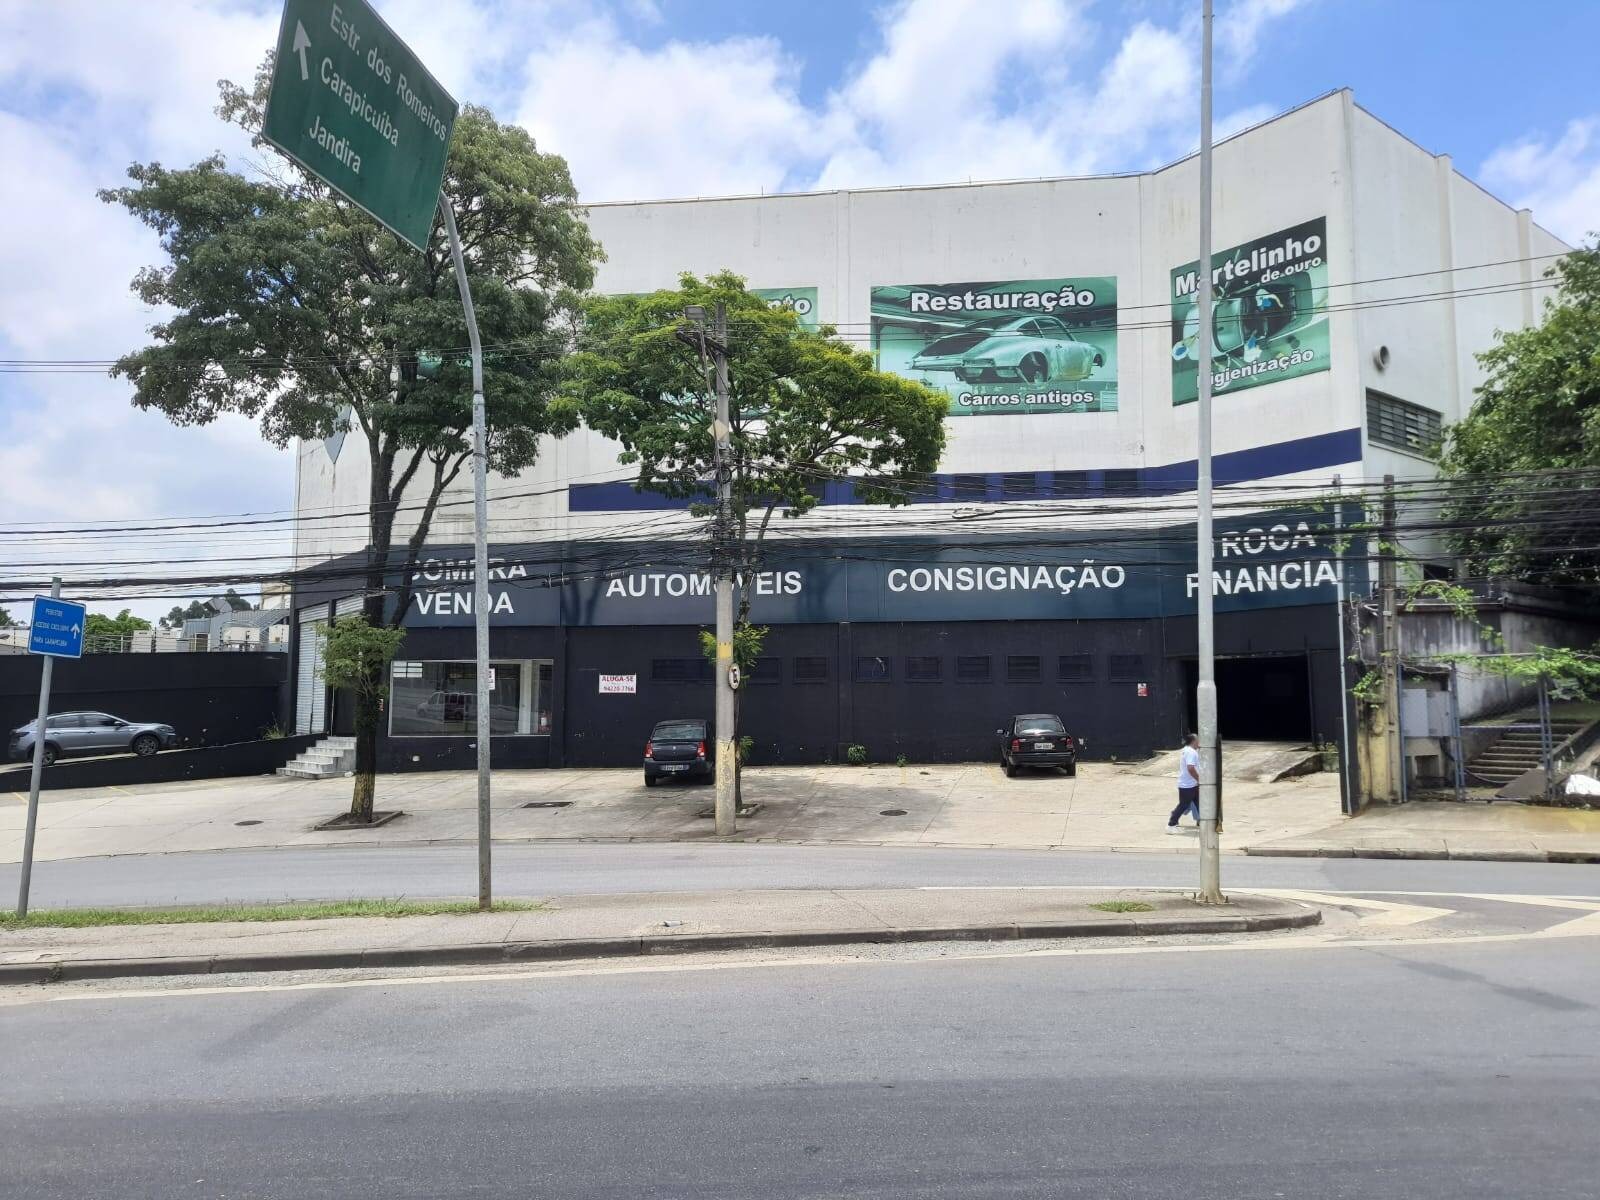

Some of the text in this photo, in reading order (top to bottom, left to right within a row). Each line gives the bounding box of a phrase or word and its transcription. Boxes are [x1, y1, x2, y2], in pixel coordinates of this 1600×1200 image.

[330, 4, 447, 142] Estr. dos Romeiros
[309, 115, 361, 175] Jandira
[1261, 257, 1322, 284] de ouro
[910, 285, 1095, 313] Restauração
[959, 390, 1094, 406] Carros antigos
[1211, 521, 1317, 559] ROCA
[606, 571, 802, 597] AUTOMVEIS
[887, 559, 1126, 595] CONSIGNAÇÃO
[1186, 560, 1338, 598] FNANCIA
